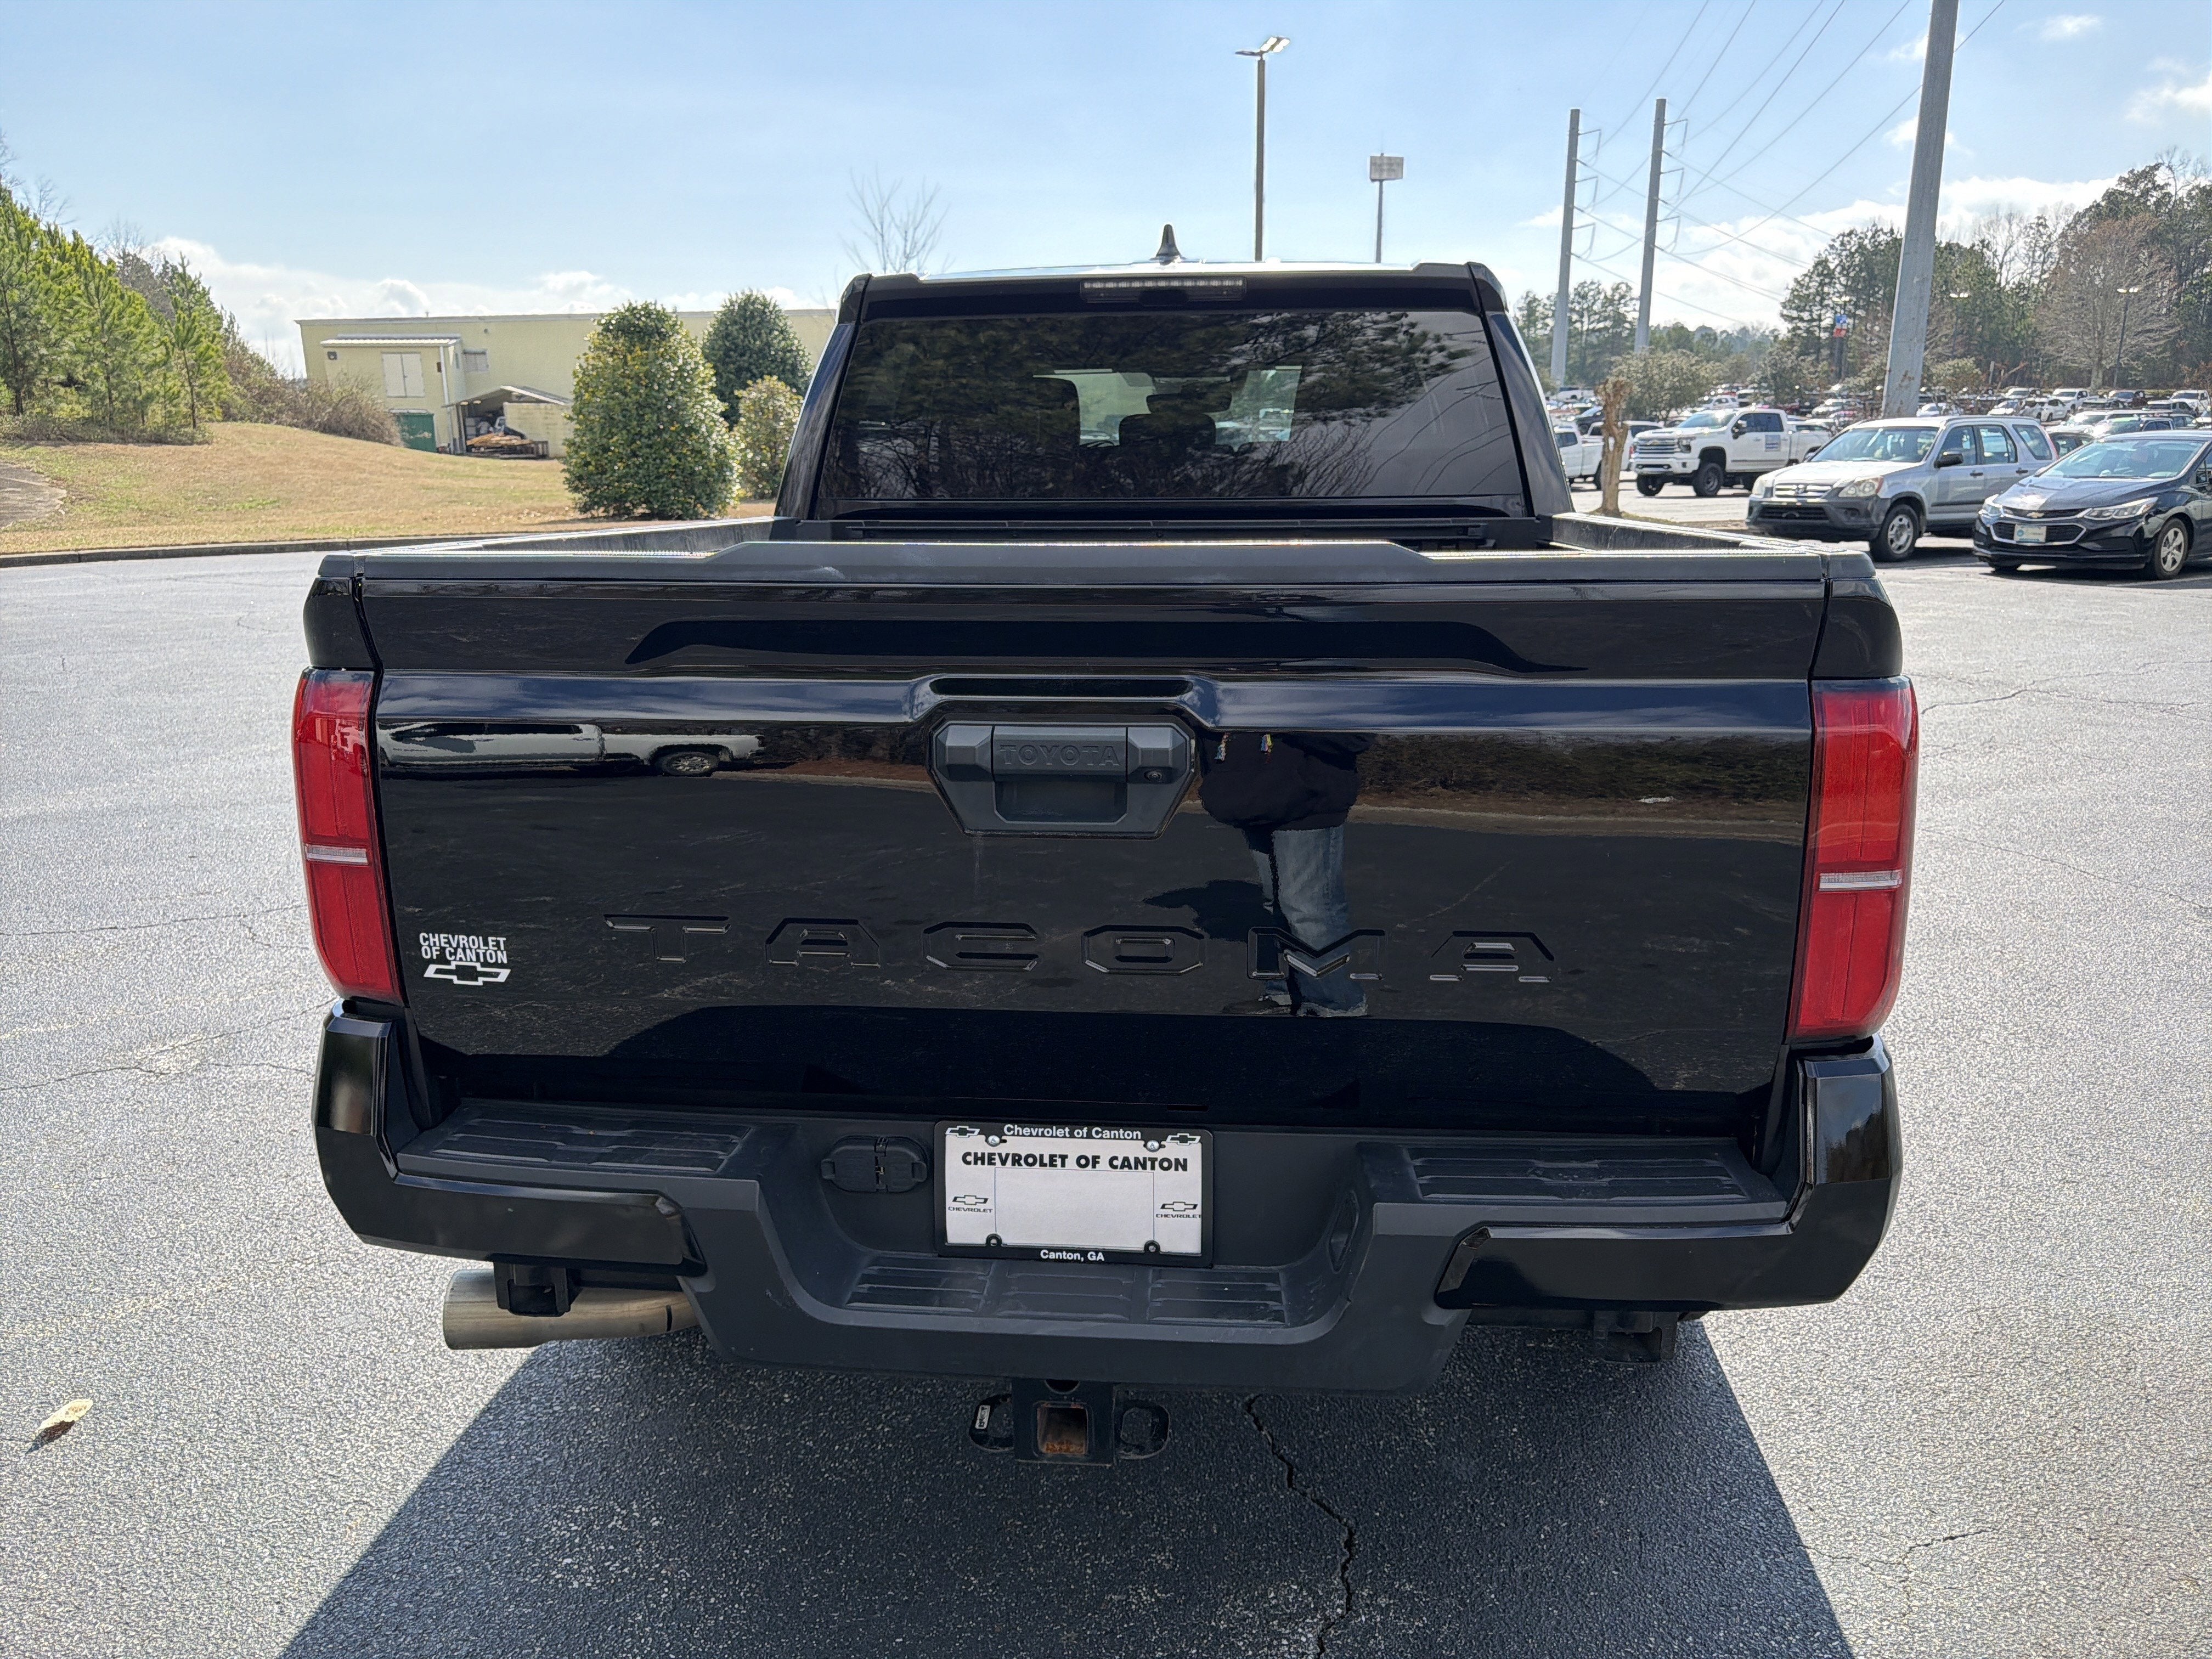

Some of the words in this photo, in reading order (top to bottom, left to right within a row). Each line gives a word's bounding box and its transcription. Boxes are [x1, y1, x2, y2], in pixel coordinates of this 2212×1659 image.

[1000, 744, 1120, 766] TOYOTA
[419, 933, 506, 950] CHEVROLET
[604, 913, 1554, 984] TACOMA
[421, 946, 440, 959] OF
[445, 947, 507, 963] CANTON
[1003, 1124, 1071, 1137] Chevrolet
[1074, 1126, 1088, 1138] of
[1092, 1127, 1141, 1139] Canton
[961, 1151, 1068, 1168] CHEVROLET
[1076, 1154, 1101, 1169] OF
[1108, 1155, 1188, 1172] CANTON
[1040, 1249, 1084, 1262] Canton,
[1087, 1251, 1105, 1262] GA
